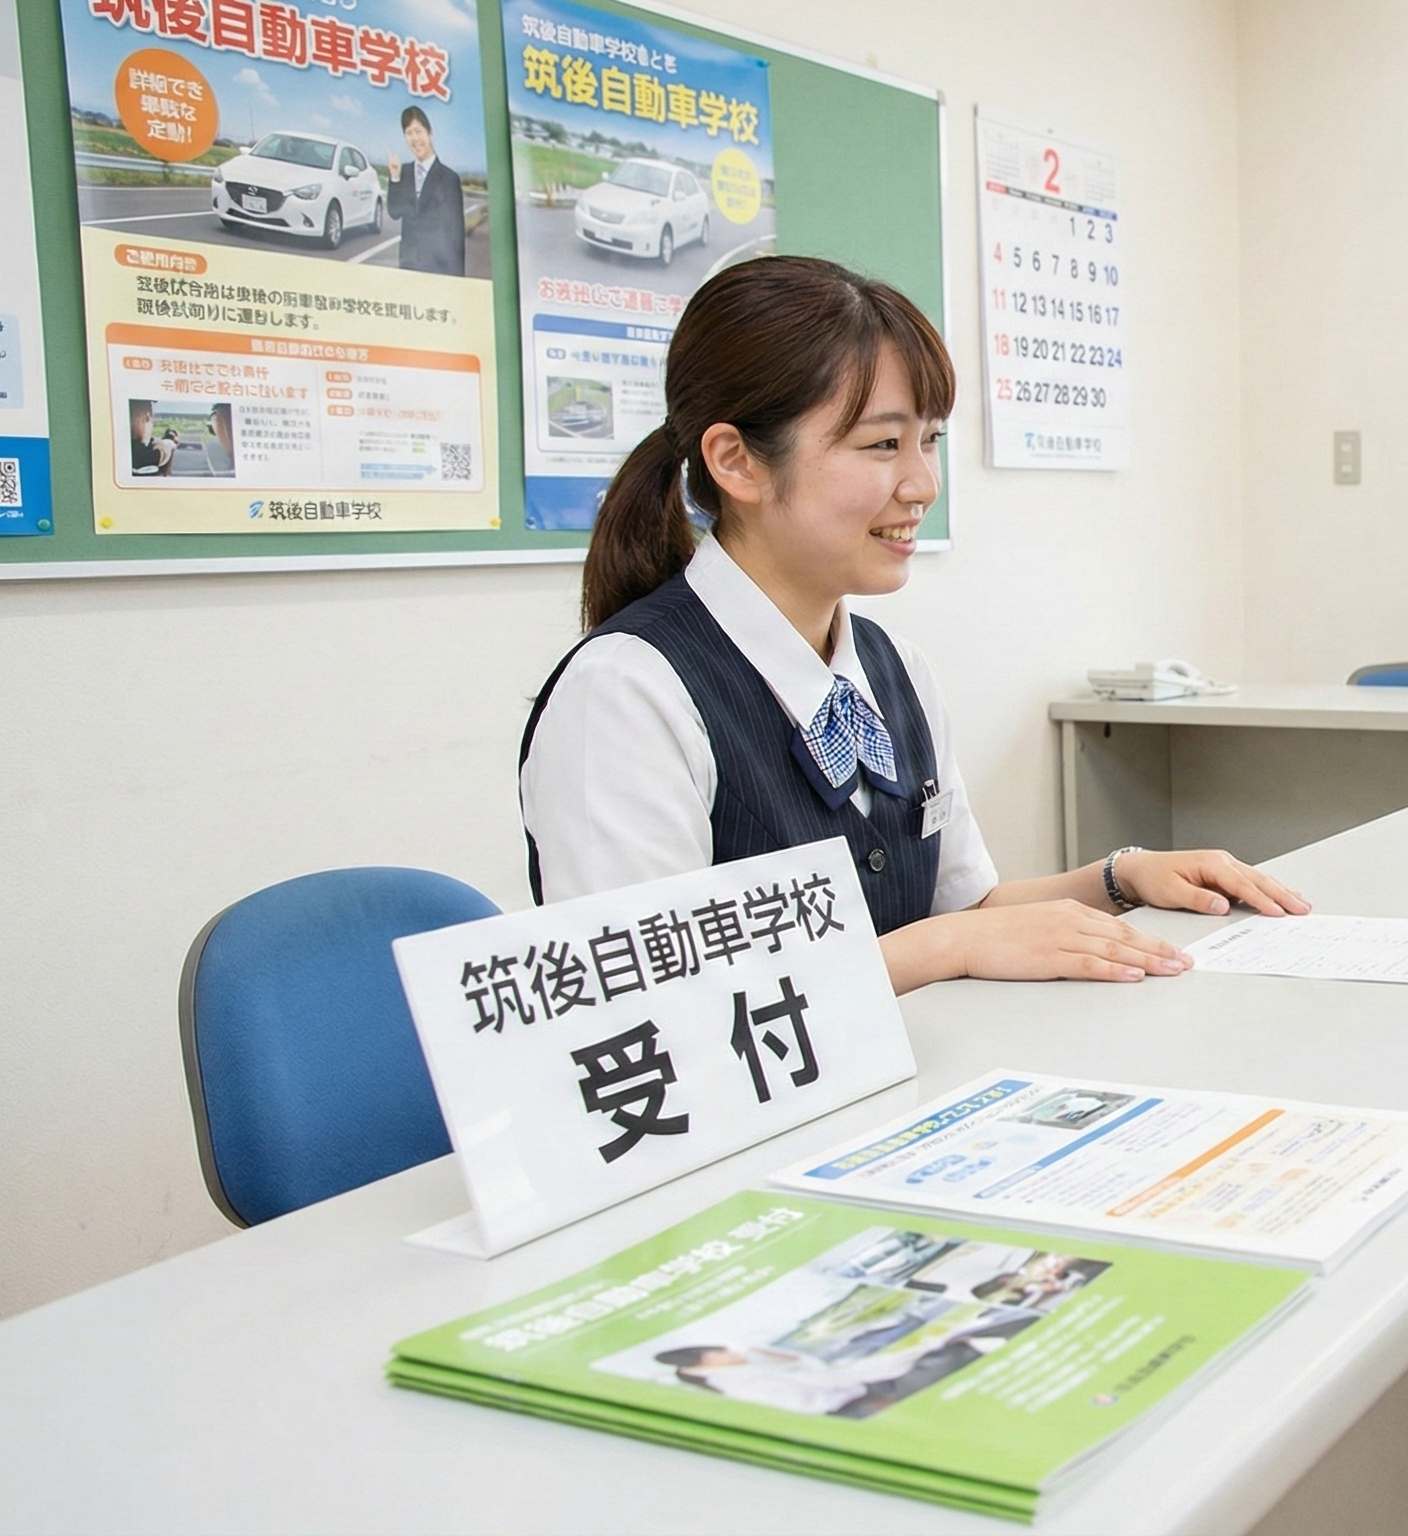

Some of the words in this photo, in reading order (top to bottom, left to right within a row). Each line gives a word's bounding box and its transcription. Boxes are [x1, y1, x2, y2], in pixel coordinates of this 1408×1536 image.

[522, 44, 759, 145] 筑後自動車学校
[1044, 148, 1060, 193] 2
[1069, 217, 1076, 237] 1
[1087, 219, 1096, 240] 2
[1104, 223, 1113, 244] 3
[993, 242, 1002, 263] 4
[1013, 247, 1022, 268] 5
[1032, 250, 1041, 272] 6
[1051, 254, 1060, 275] 7
[1070, 258, 1078, 279] 8
[1088, 261, 1097, 282] 9
[1103, 265, 1119, 287] 10
[993, 288, 1006, 310] 11
[1012, 292, 1027, 314] 12
[1031, 295, 1047, 317] 13
[1051, 298, 1065, 320] 14
[1069, 301, 1084, 322] 15
[1087, 304, 1102, 325] 16
[1105, 306, 1119, 326] 17
[994, 333, 1009, 356] 18
[1013, 336, 1029, 358] 19
[1032, 338, 1049, 360] 20
[1052, 340, 1066, 362] 21
[1070, 343, 1086, 364] 22
[1089, 345, 1105, 366] 23
[1107, 347, 1122, 368] 24
[996, 378, 1013, 401] 25
[1015, 380, 1032, 402] 26
[1034, 382, 1050, 403] 27
[1054, 383, 1070, 405] 28
[1072, 386, 1088, 407] 29
[1090, 387, 1107, 408] 30
[460, 872, 846, 1034] 筑後自動車学校
[570, 975, 820, 1164] 受付
